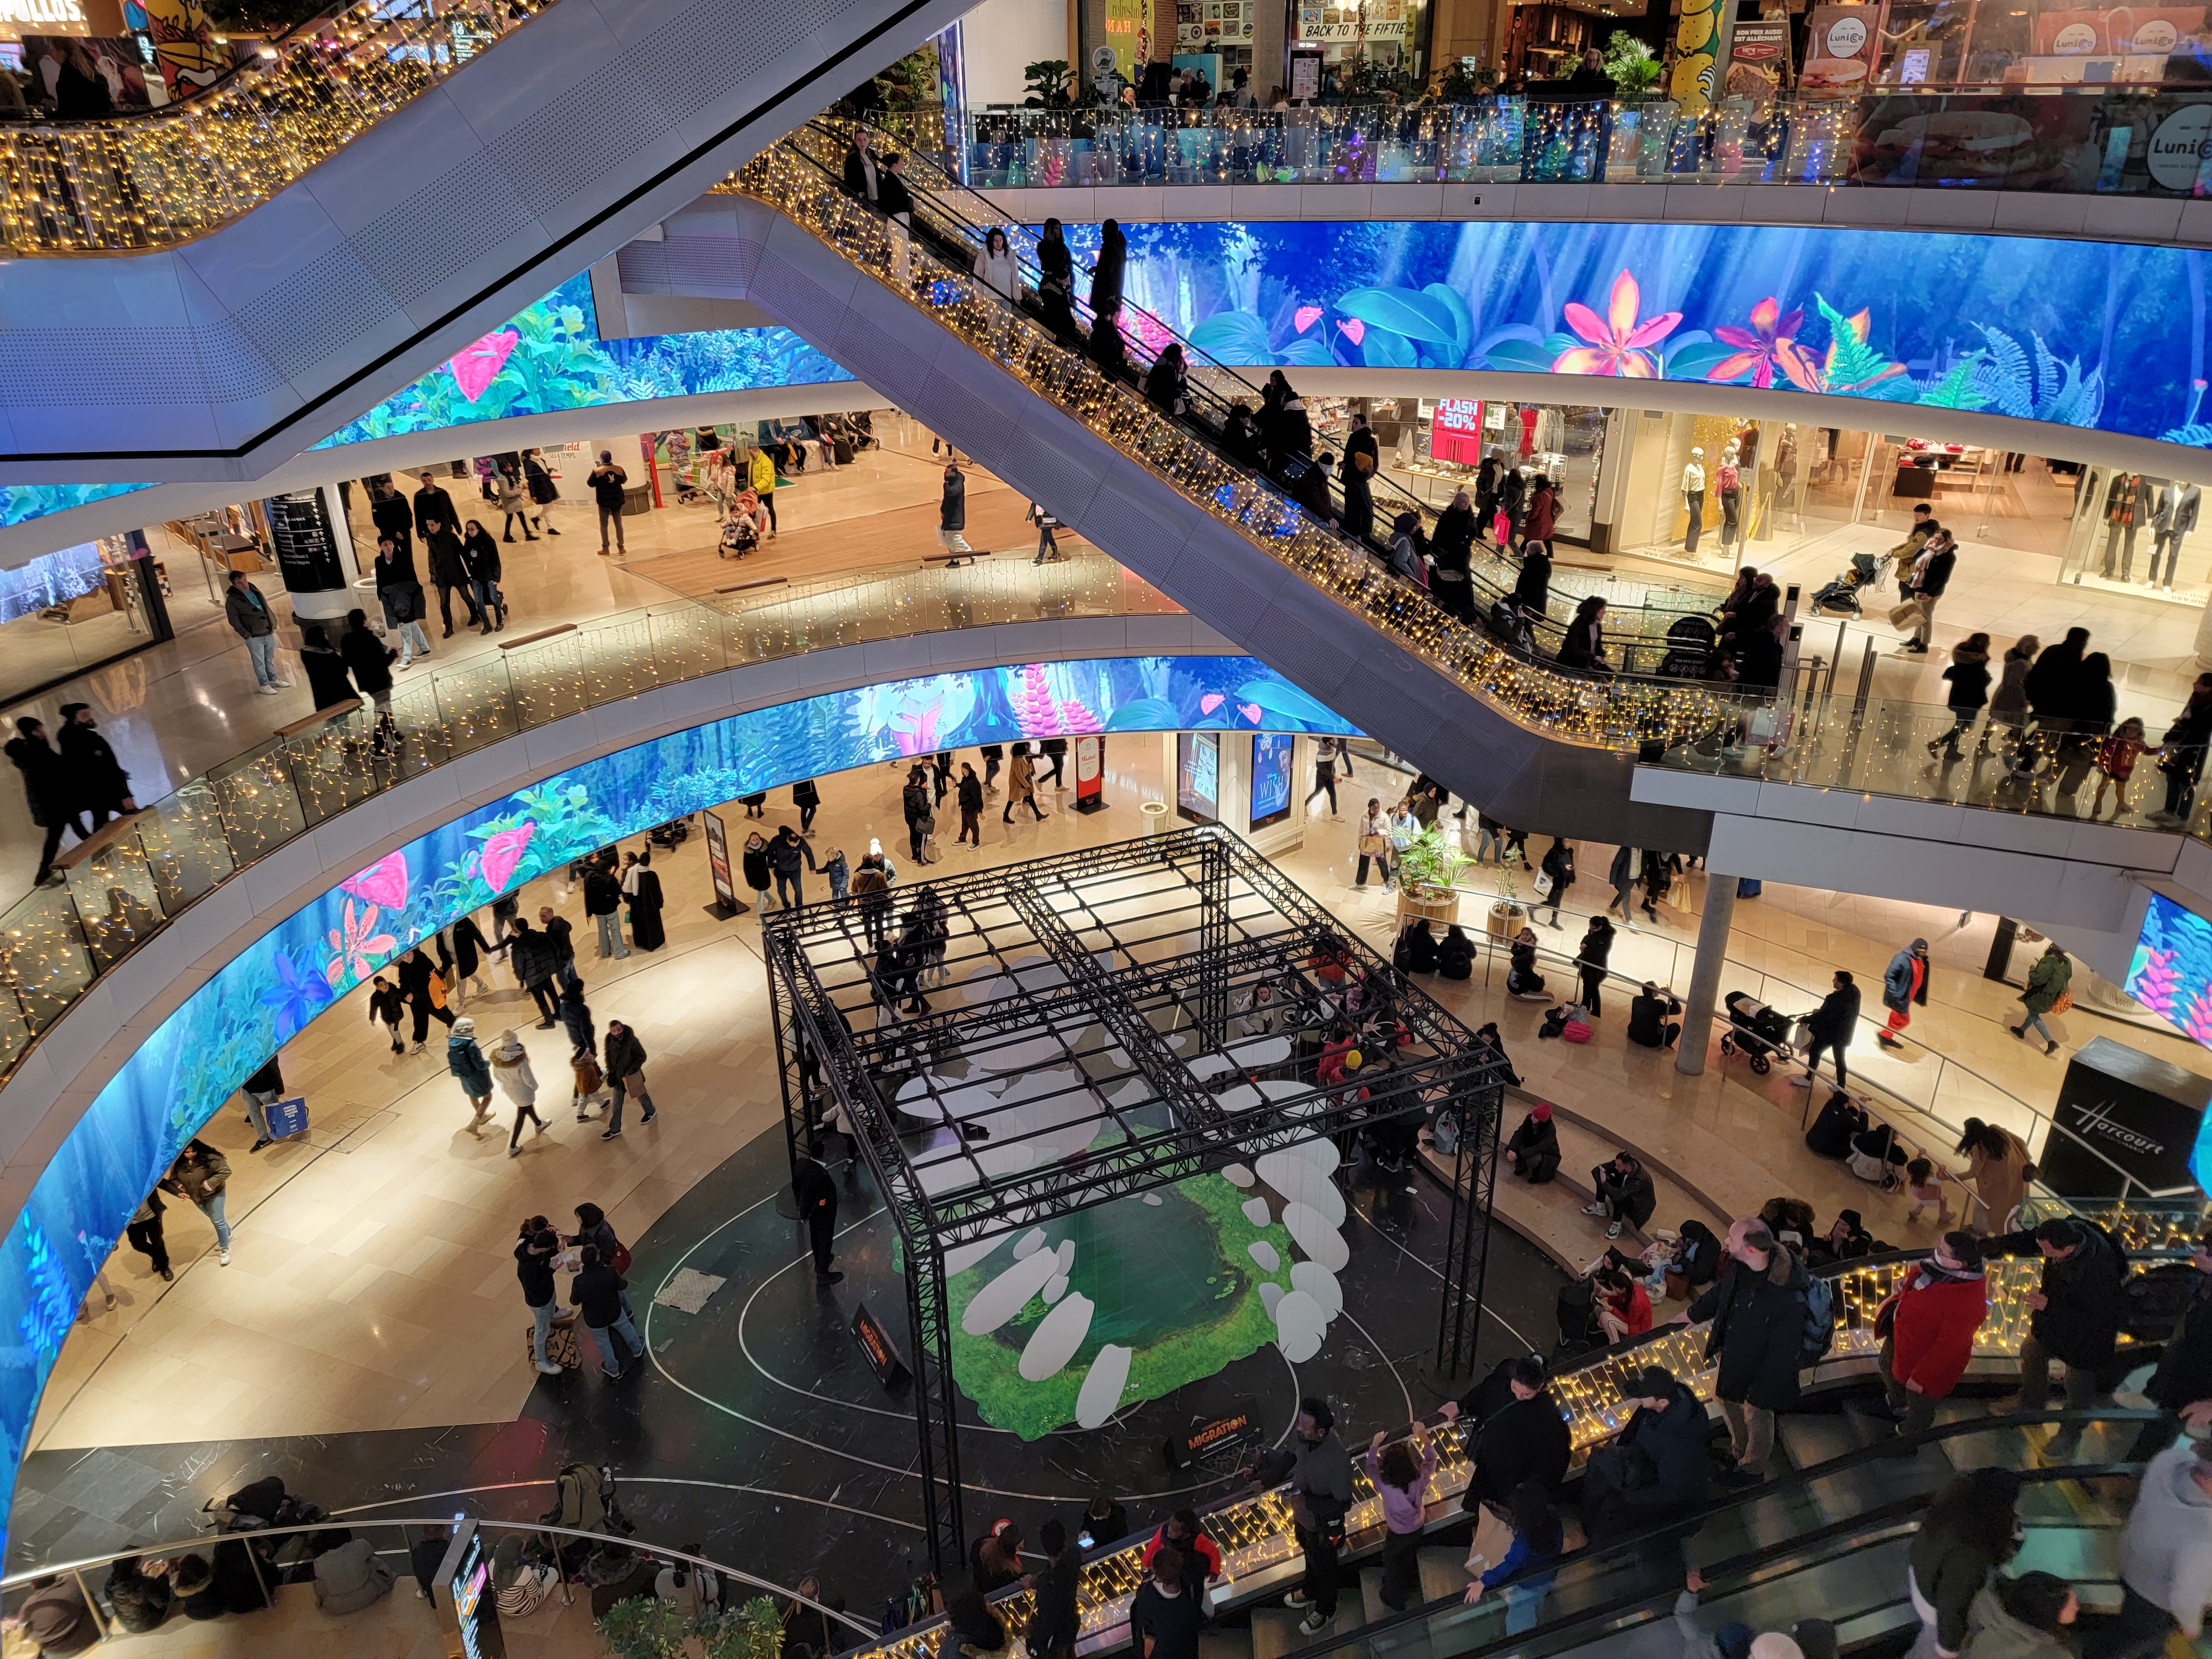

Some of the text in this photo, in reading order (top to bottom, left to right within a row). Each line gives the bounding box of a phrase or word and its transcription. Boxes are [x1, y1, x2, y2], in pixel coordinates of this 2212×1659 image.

[1306, 22, 1406, 37] BACK TO TE FIFTIE
[1439, 398, 1478, 416] FLASH
[1439, 412, 1475, 431] -20%
[1260, 775, 1283, 799] WISH
[859, 1319, 888, 1366] MIGRATION
[1188, 1414, 1247, 1451] MIGRATION
